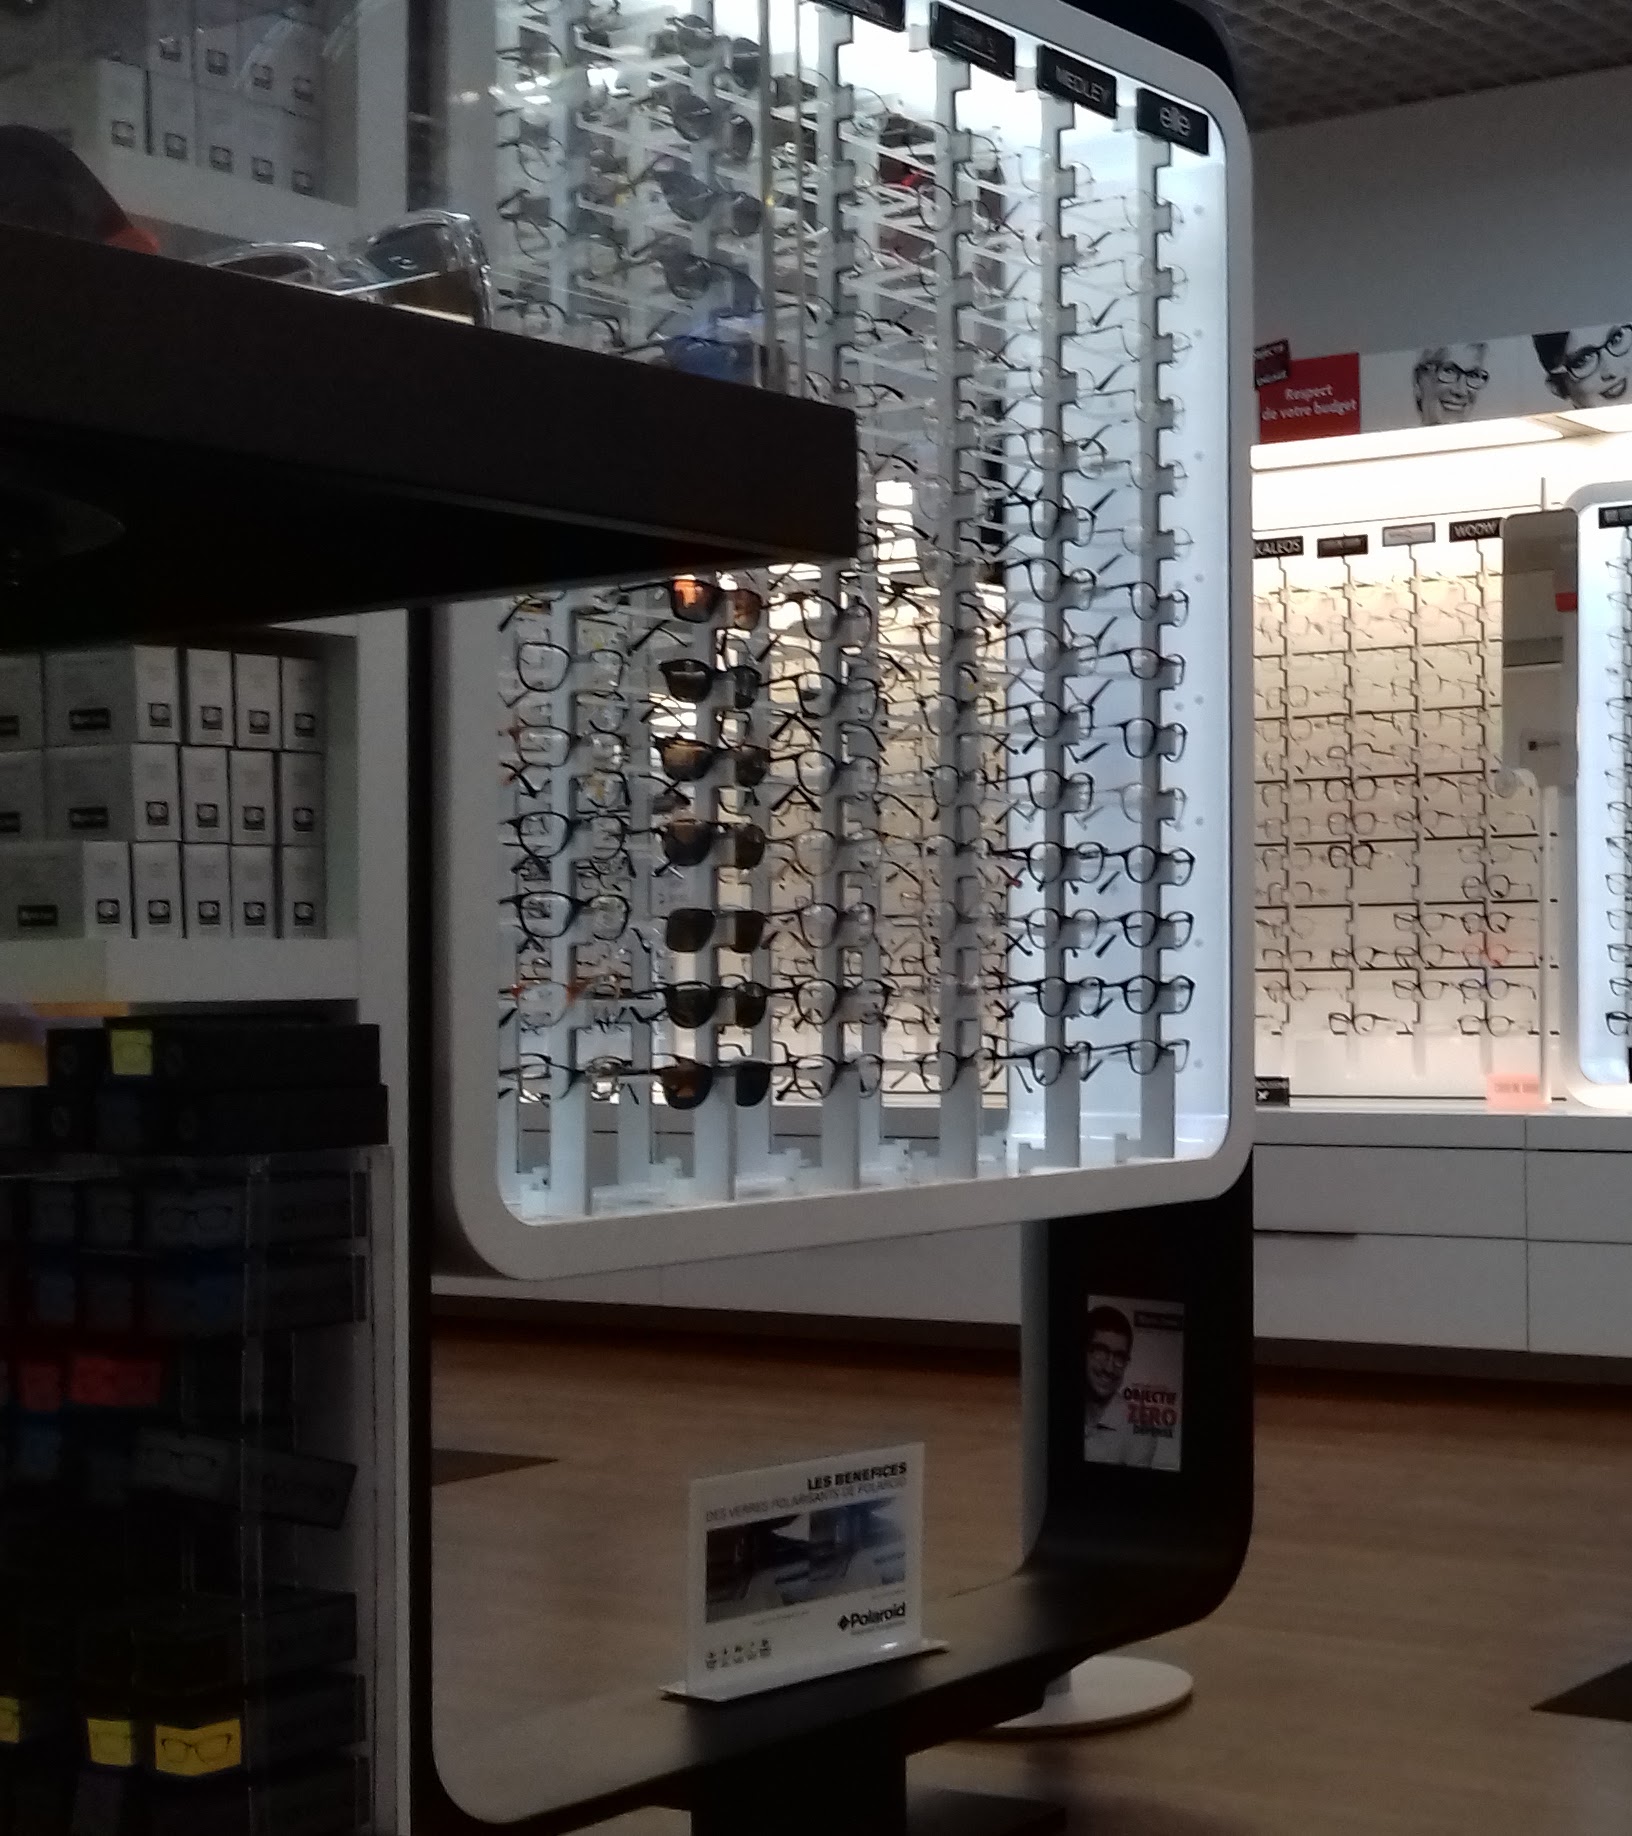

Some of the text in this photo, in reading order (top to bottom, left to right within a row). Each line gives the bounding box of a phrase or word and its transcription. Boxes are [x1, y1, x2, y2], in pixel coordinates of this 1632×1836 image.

[1285, 384, 1333, 401] Respect
[1262, 399, 1357, 420] de votre budget
[1453, 520, 1498, 538] WOOW
[806, 1472, 832, 1491] LES
[851, 1602, 906, 1627] Polaroid
